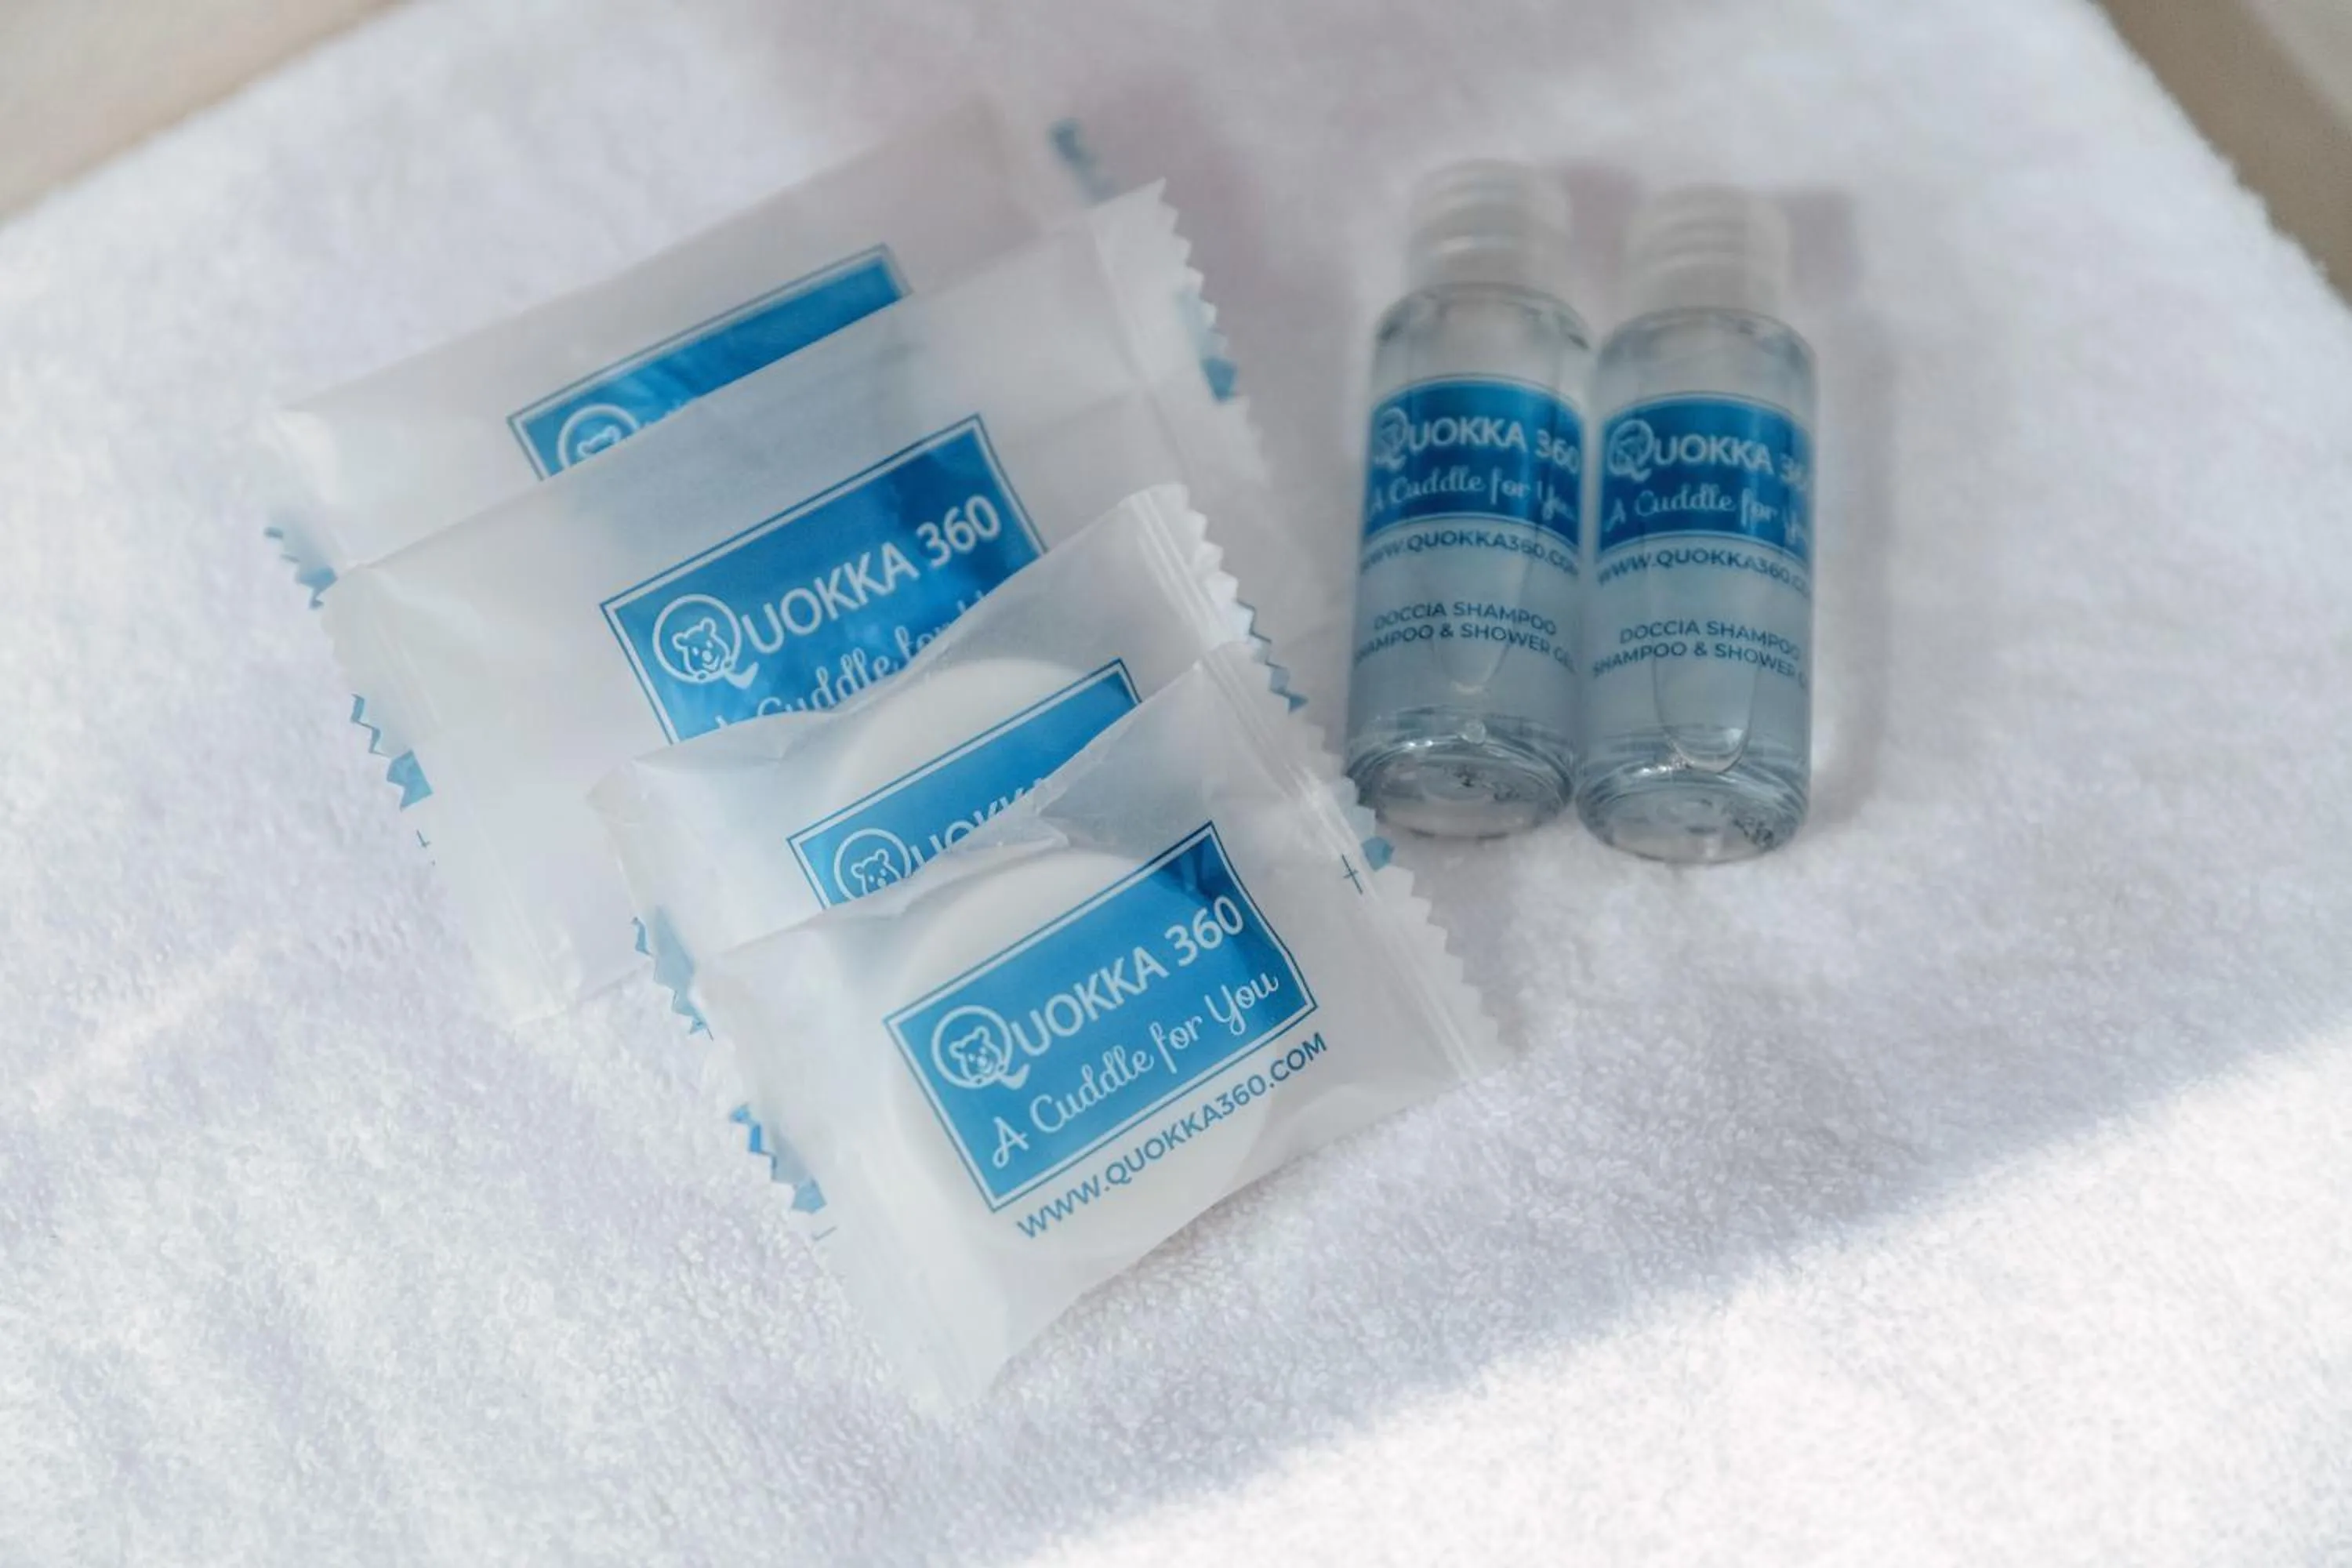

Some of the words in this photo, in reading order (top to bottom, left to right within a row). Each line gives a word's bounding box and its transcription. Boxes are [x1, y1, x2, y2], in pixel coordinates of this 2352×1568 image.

[1372, 406, 1529, 472] QUOKKA
[1534, 428, 1581, 474] 360
[1606, 418, 1774, 481] QUOKKA
[1388, 464, 1486, 506] Cuddle
[1491, 466, 1532, 506] for
[1604, 497, 1627, 532] A
[1635, 483, 1737, 517] Cuddle
[1740, 486, 1779, 528] for
[652, 541, 920, 689] QUOKKA
[916, 494, 1001, 568] 360
[1374, 601, 1448, 631] DOCCIA
[1453, 601, 1557, 637] SHAMPOO
[1440, 622, 1454, 639] &
[1461, 622, 1551, 655] SHOWER
[1620, 619, 1700, 644] DOCCIA
[1693, 641, 1708, 657] &
[931, 946, 1170, 1089] QUOKKA
[1163, 895, 1245, 967] 360
[991, 1116, 1029, 1168] A
[1029, 1044, 1156, 1134] Cuddle
[1149, 1020, 1203, 1073] for
[1204, 972, 1280, 1036] You
[1016, 1032, 1328, 1239] WWW.QUOKKA360.COM
